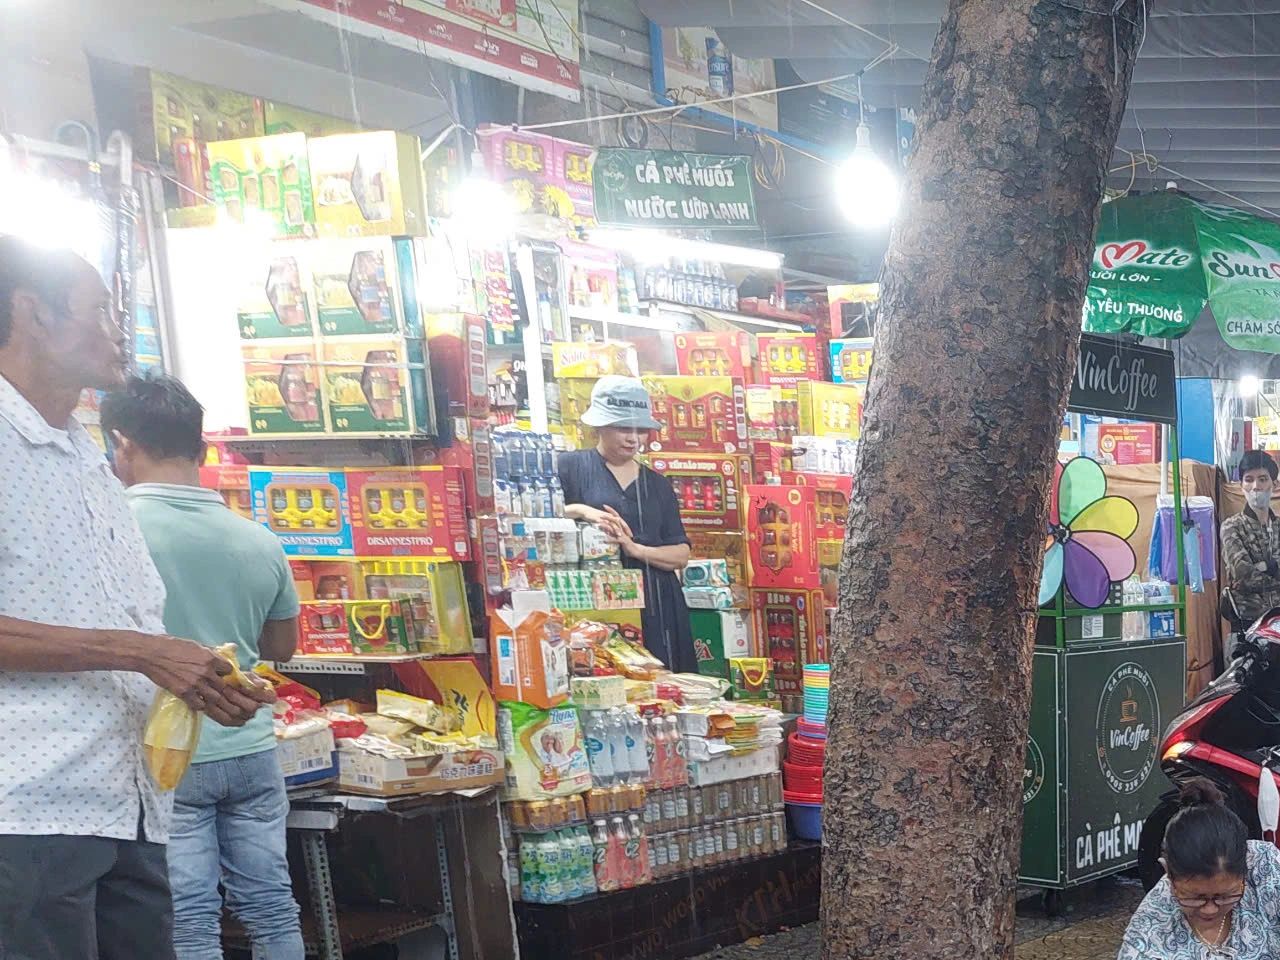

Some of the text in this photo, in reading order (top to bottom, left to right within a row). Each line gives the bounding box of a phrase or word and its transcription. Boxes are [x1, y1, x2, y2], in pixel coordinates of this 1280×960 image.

[663, 164, 692, 185] PHÊ
[692, 165, 735, 188] MUỐI
[625, 196, 679, 219] NƯỚC
[711, 202, 750, 225] LẠNH
[1120, 272, 1150, 283] LỚN
[1097, 297, 1123, 314] YÊU
[1127, 302, 1183, 323] THƯƠNG
[1227, 320, 1263, 335] CHĂM
[1077, 350, 1158, 412] VinCoffee
[606, 398, 649, 410] BALENCIAGA
[1118, 666, 1132, 680] PHÊ
[1110, 722, 1151, 752] VinCoffee
[1076, 822, 1094, 869] CÀ
[1097, 812, 1121, 863] PHÊ
